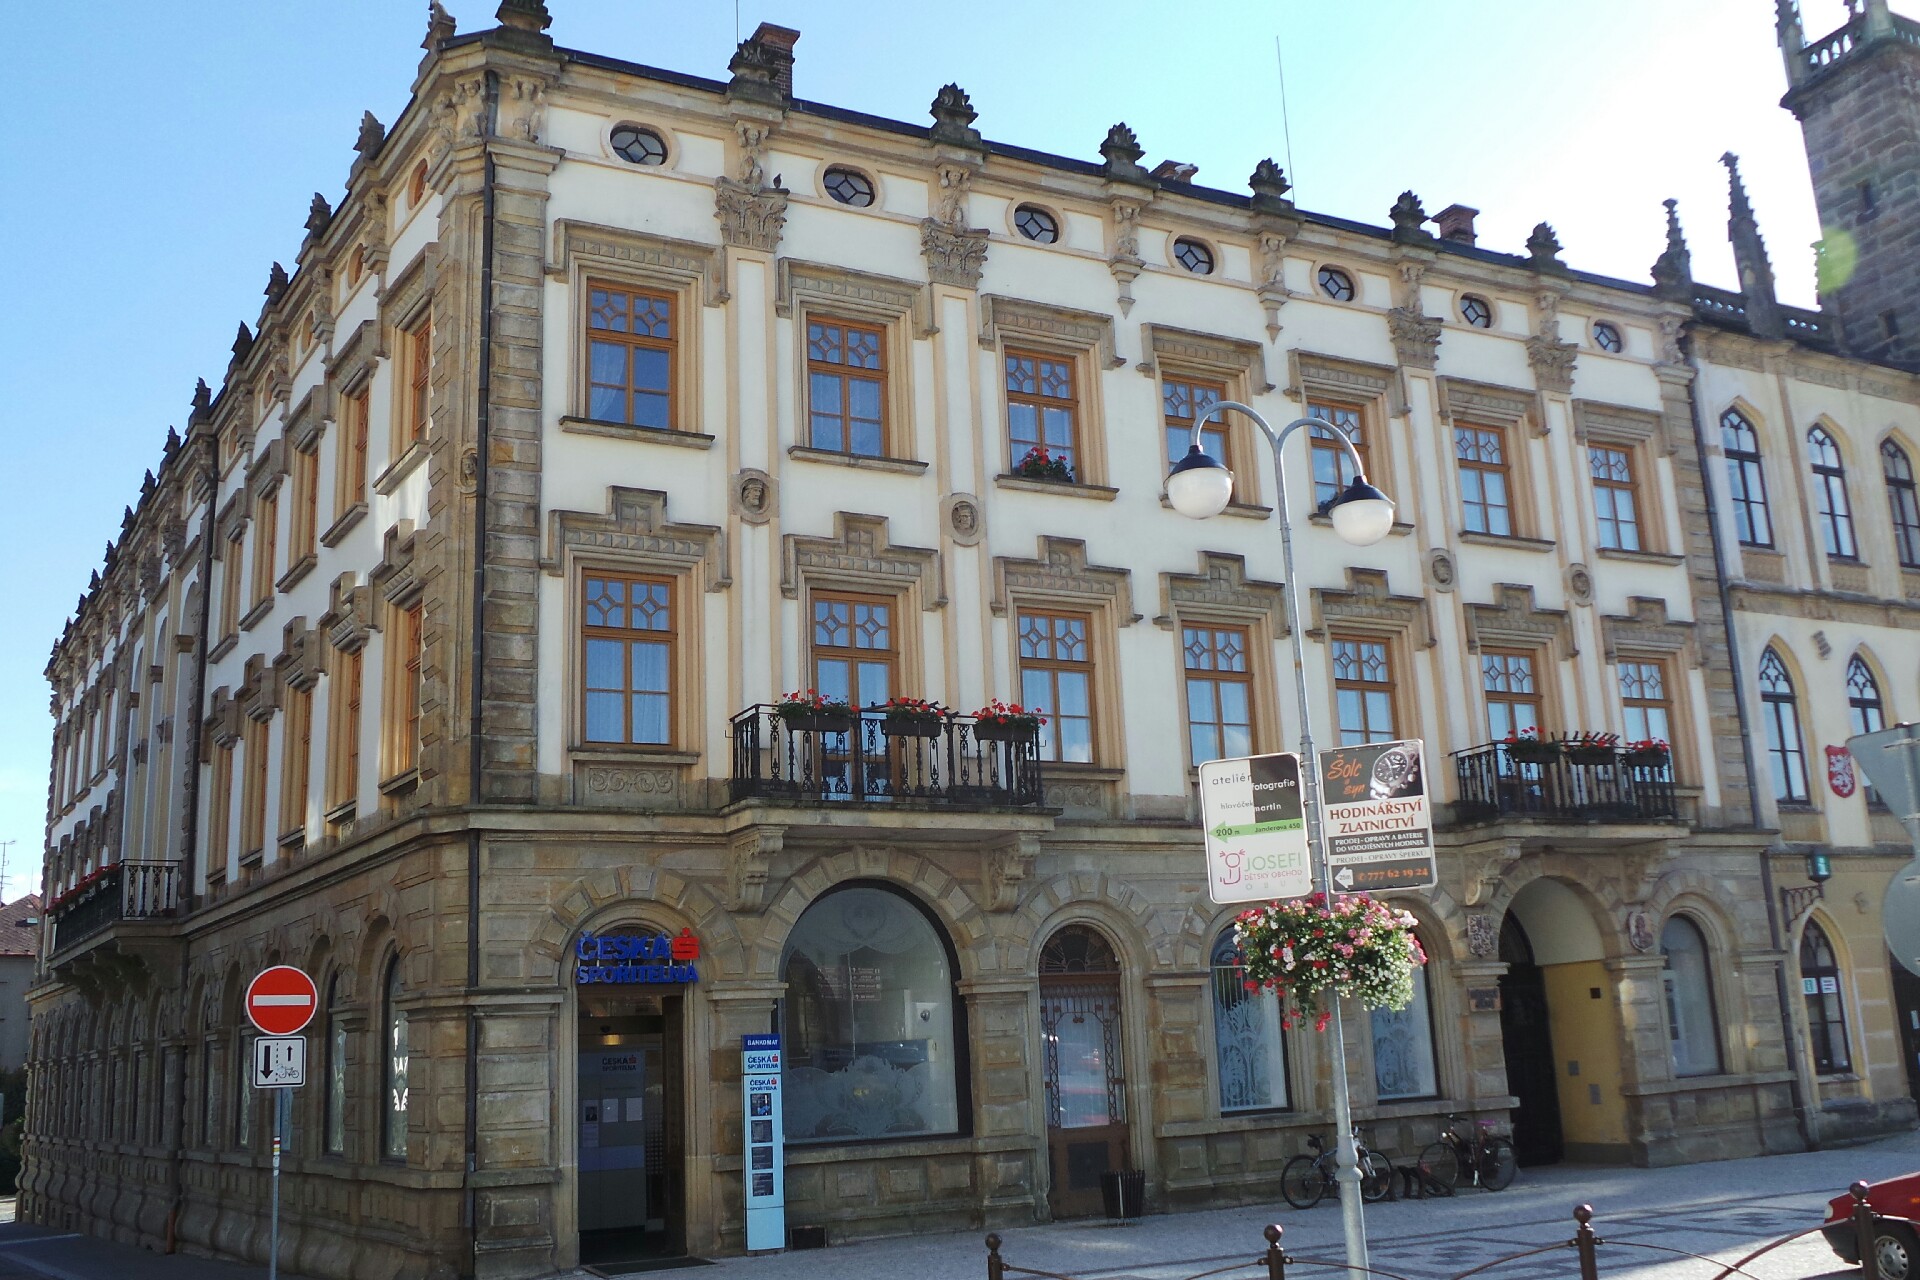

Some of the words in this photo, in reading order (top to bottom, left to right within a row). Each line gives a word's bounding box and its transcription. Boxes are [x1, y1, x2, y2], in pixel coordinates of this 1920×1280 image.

[1327, 754, 1362, 779] Šolc
[1212, 772, 1252, 785] ateliér
[1252, 778, 1295, 791] fotografie
[1343, 783, 1366, 799] syn
[1220, 800, 1254, 810] hlaváček
[1254, 802, 1282, 812] martin
[1330, 798, 1422, 820] HODINÁŘSTVÍ
[1254, 824, 1287, 833] Janderova
[1339, 814, 1415, 834] ZLATNICTVÍ
[1216, 828, 1233, 837] 200
[1335, 837, 1360, 846] PRODEJ
[1364, 834, 1391, 843] OPRAVY
[1397, 832, 1424, 840] BATERIE
[1395, 839, 1425, 847] HODINEK
[1336, 856, 1364, 864] PRODEJ
[1368, 852, 1397, 861] OPRAVY
[1271, 869, 1302, 878] OBCHOD
[576, 930, 671, 960] ČESKÁ
[576, 962, 699, 984] SPOŘITELNA
[747, 1054, 772, 1063] ČESKÁ
[750, 1078, 771, 1086] ČESKÁ
